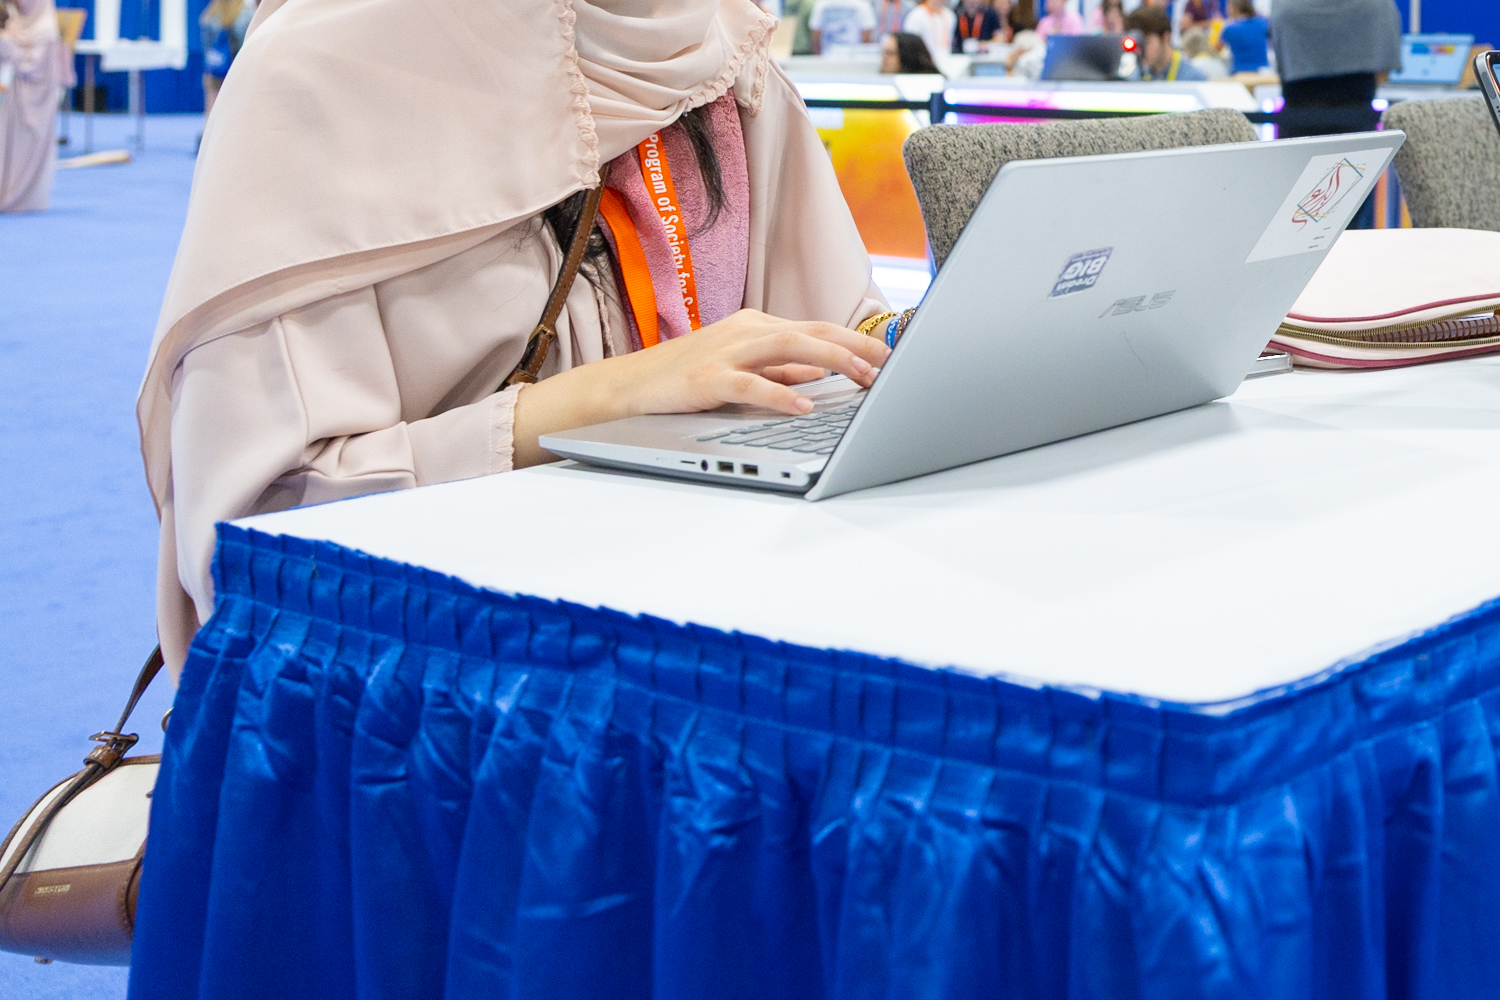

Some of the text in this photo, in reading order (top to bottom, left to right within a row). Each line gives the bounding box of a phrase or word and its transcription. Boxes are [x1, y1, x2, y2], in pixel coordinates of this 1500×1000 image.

[645, 133, 667, 194] Program
[657, 197, 676, 211] of
[1061, 255, 1108, 280] BIG
[1097, 289, 1177, 319] ASUS
